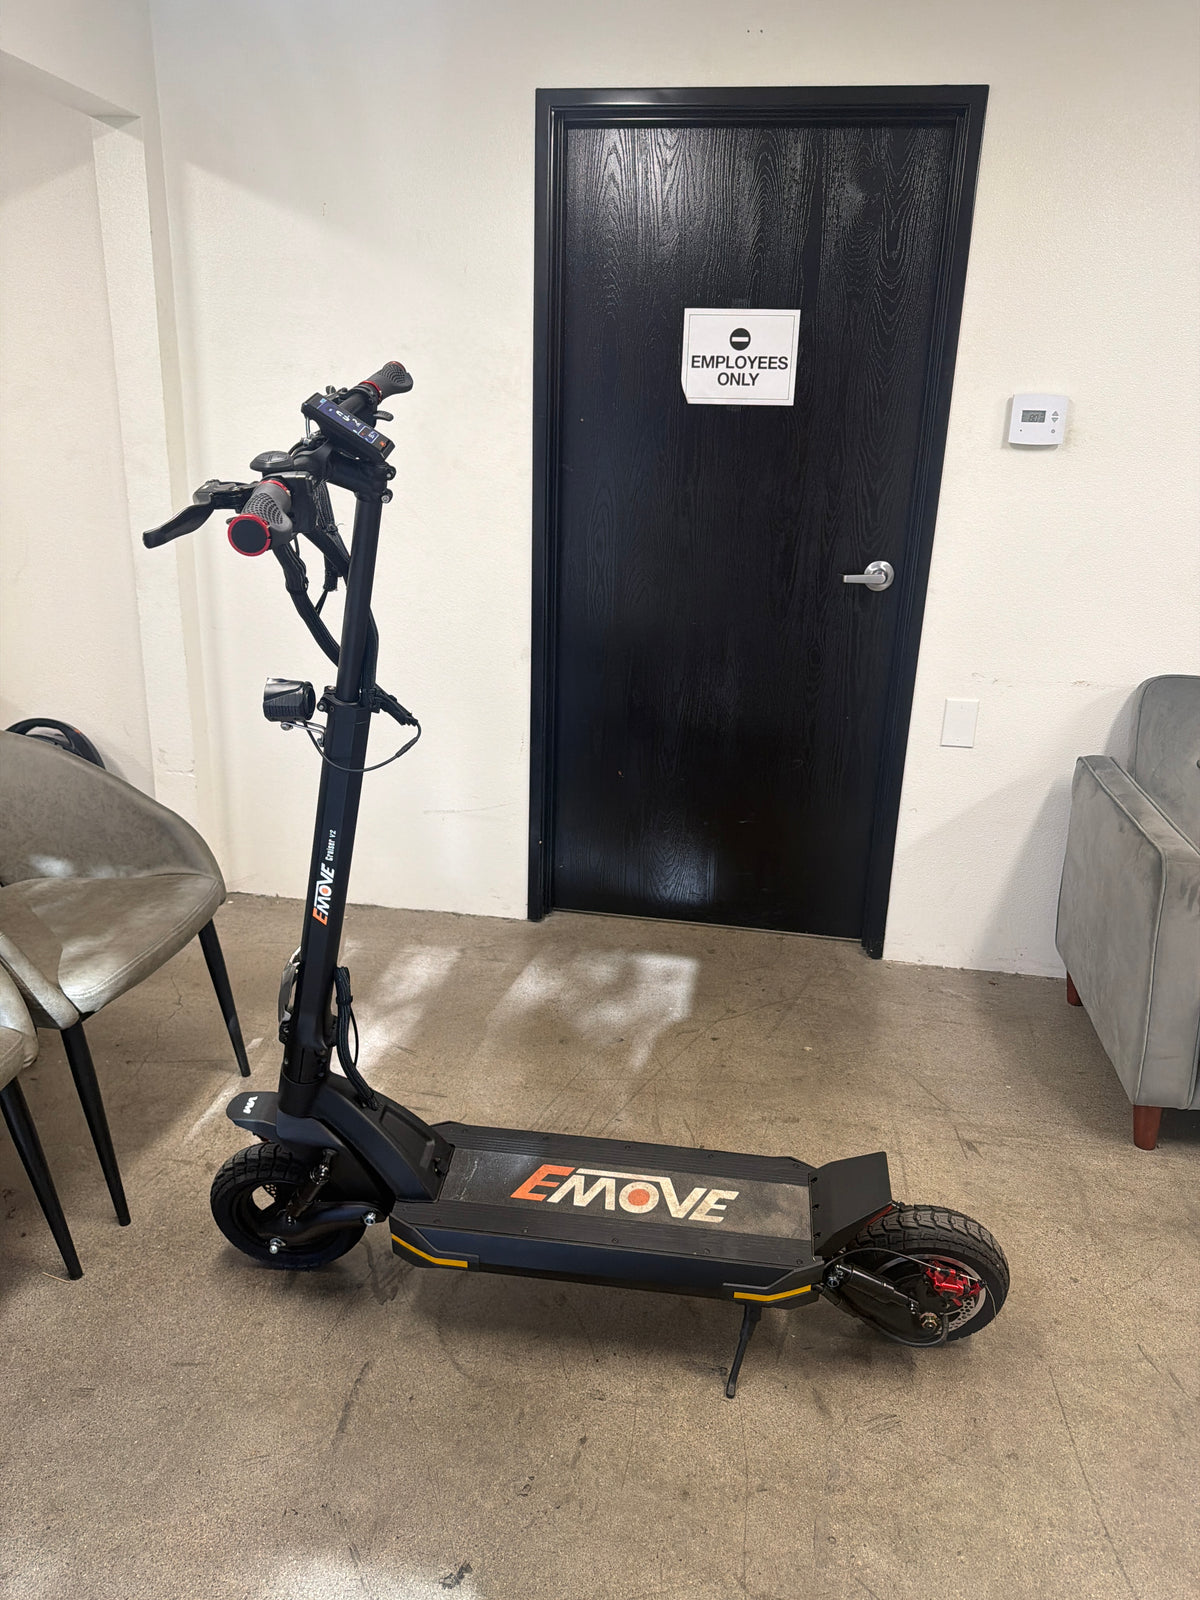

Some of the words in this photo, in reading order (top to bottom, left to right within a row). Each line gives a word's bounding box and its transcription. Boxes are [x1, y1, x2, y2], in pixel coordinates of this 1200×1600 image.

[691, 355, 788, 370] EMPLOYEES
[717, 372, 760, 386] ONLY
[312, 863, 335, 926] EMOVE
[325, 839, 336, 861] Cruiser
[510, 1164, 740, 1223] EMOVE
